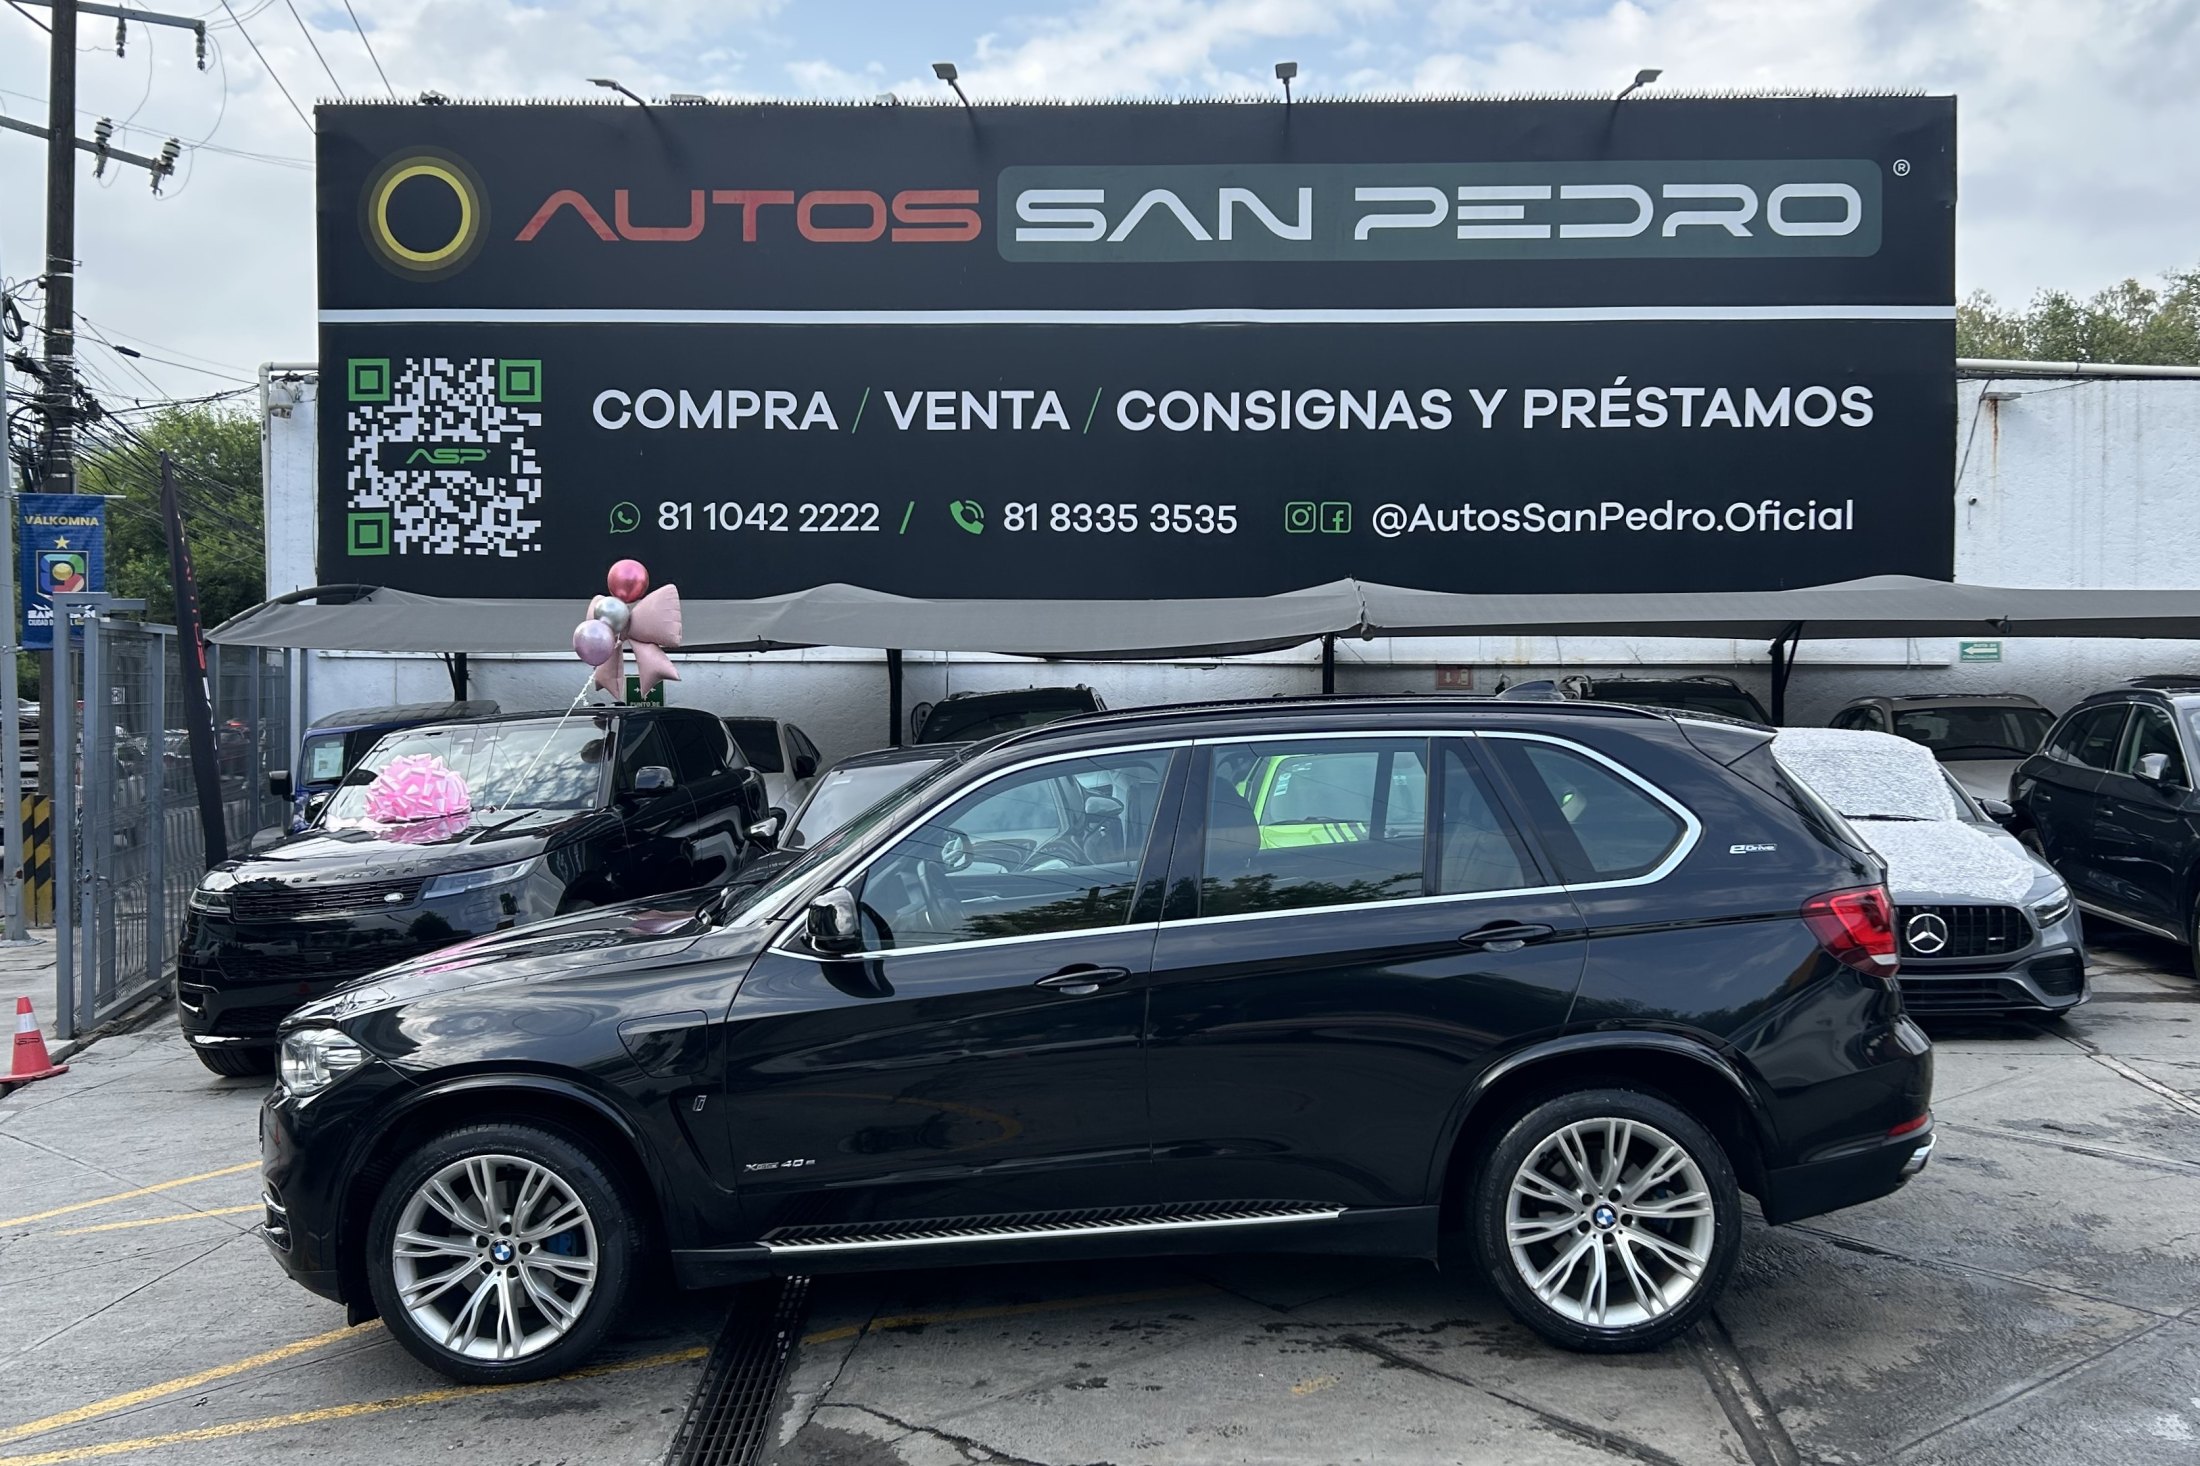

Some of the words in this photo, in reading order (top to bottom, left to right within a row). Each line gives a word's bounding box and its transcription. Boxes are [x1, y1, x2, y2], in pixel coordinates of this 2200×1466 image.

[514, 190, 981, 242] AUTOS
[1015, 188, 1312, 242] SAN
[1354, 183, 1862, 241] PEDRO
[592, 388, 839, 430] COMPRA
[884, 390, 1071, 431] VENTA
[1116, 388, 1452, 432] CONSIGNAS
[1468, 389, 1508, 429] Y
[1523, 375, 1875, 429] PRÉSTAMOS
[658, 501, 692, 531] 81
[703, 501, 789, 532] 1042
[798, 502, 880, 532] 2222
[1003, 502, 1038, 532] 81
[1049, 502, 1138, 533] 8335
[1149, 503, 1238, 534] 3535
[1372, 499, 1853, 539] @AutosSanPedro.Oficial
